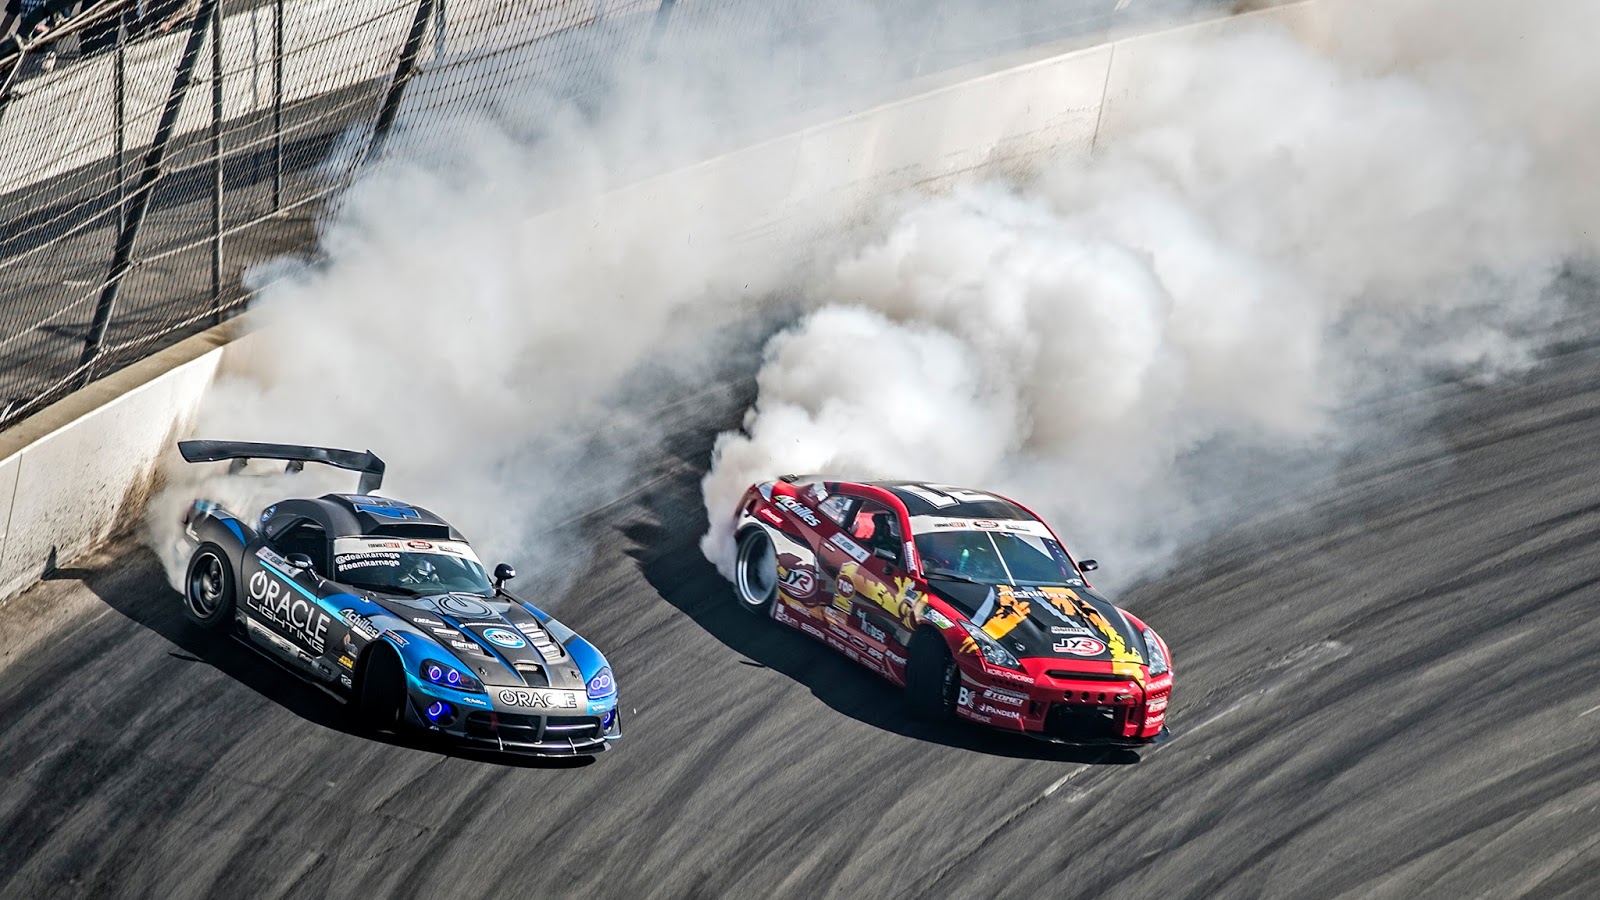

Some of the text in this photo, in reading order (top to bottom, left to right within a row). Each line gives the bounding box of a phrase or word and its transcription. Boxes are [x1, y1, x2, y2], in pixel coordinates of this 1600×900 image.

[774, 495, 821, 527] Achilles
[336, 552, 400, 564] @deankarnage
[338, 560, 400, 572] #teamkarnage
[838, 578, 853, 594] TOP
[249, 570, 331, 645] ORACLE
[247, 596, 324, 653] LIGHTING
[339, 608, 379, 638] Achilles
[451, 640, 479, 651] Garrett
[499, 689, 577, 709] ORACLE
[986, 705, 1020, 719] PANDEM
